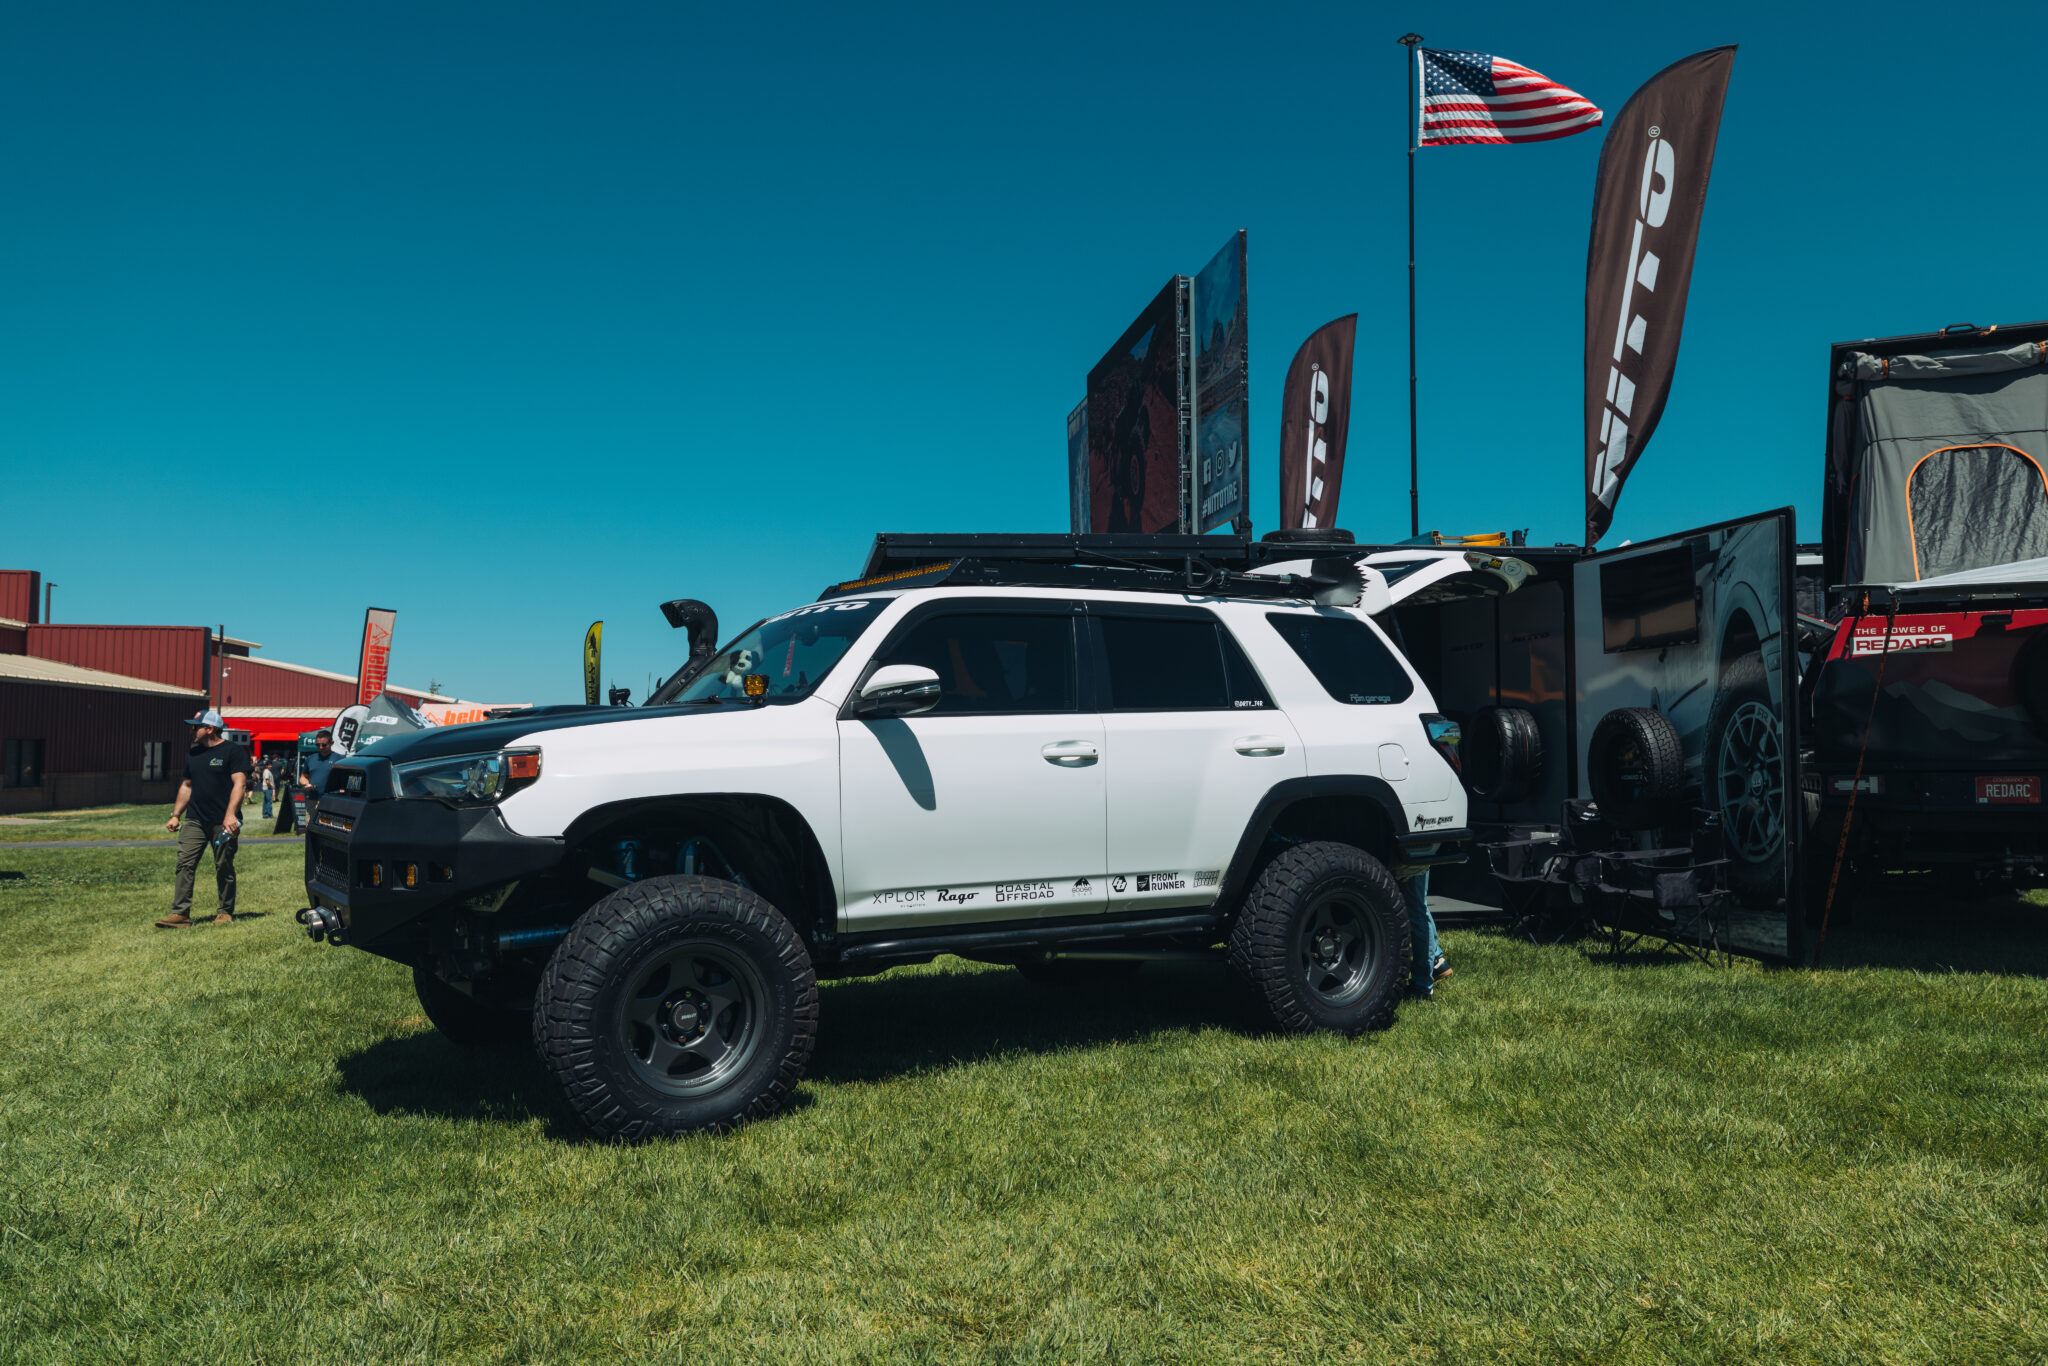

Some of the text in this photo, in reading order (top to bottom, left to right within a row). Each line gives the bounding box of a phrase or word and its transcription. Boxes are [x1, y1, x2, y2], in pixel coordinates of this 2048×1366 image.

[1592, 138, 1676, 510] NITTO
[1302, 369, 1329, 528] ITTO
[1202, 481, 1238, 518] #NITTOTIRE
[1855, 625, 1946, 635] THE POWER OF
[1855, 637, 1947, 651] REDARC
[365, 645, 390, 704] belltec
[1985, 783, 2032, 798] REDARC
[1151, 872, 1179, 882] FRONT
[995, 882, 1054, 893] COASTAL
[1151, 880, 1186, 891] RUNNER
[872, 890, 926, 904] XPLOR
[936, 888, 980, 905] Rago
[995, 891, 1055, 902] OFFROAD
